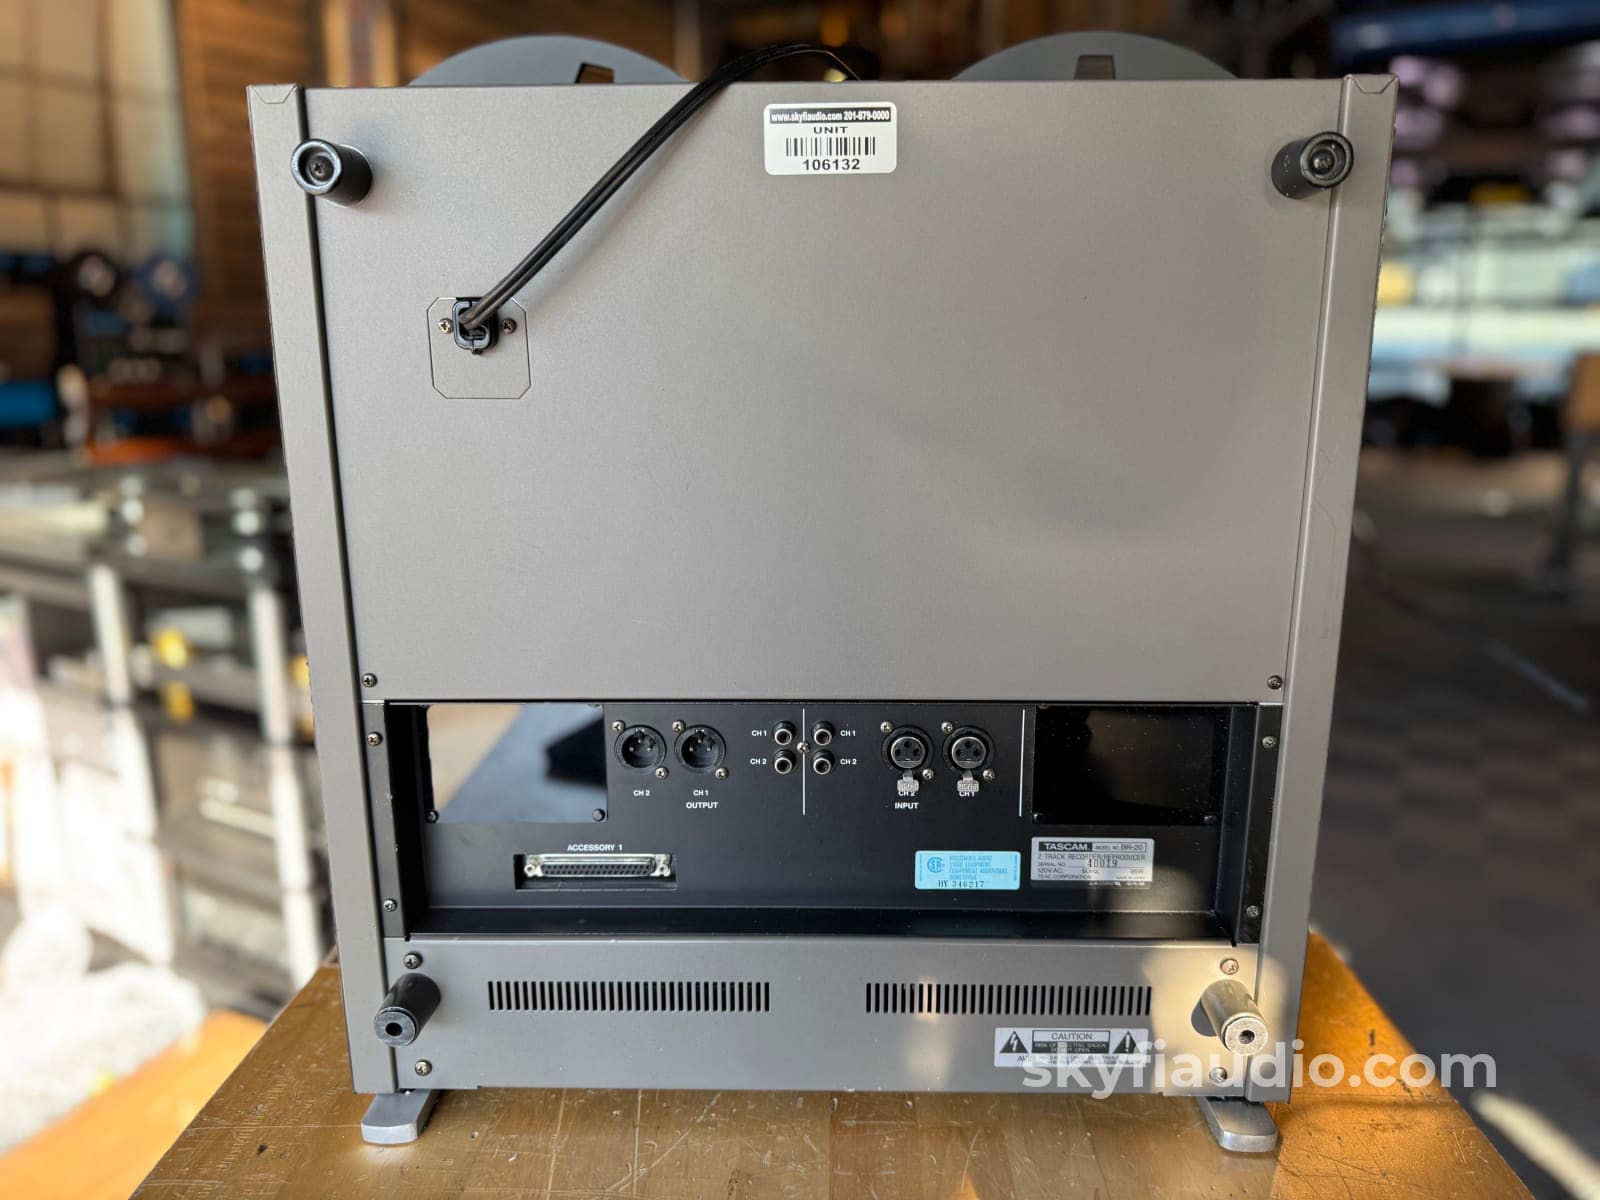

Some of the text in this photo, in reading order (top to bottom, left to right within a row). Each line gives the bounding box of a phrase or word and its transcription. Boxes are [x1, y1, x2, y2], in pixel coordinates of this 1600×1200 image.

[771, 110, 890, 123] www.skyfiaudio.com 201-879-0000
[813, 126, 848, 134] UNIT
[803, 158, 860, 171] 106132
[1044, 843, 1088, 851] TASCAM
[1051, 1032, 1092, 1041] CAUTION
